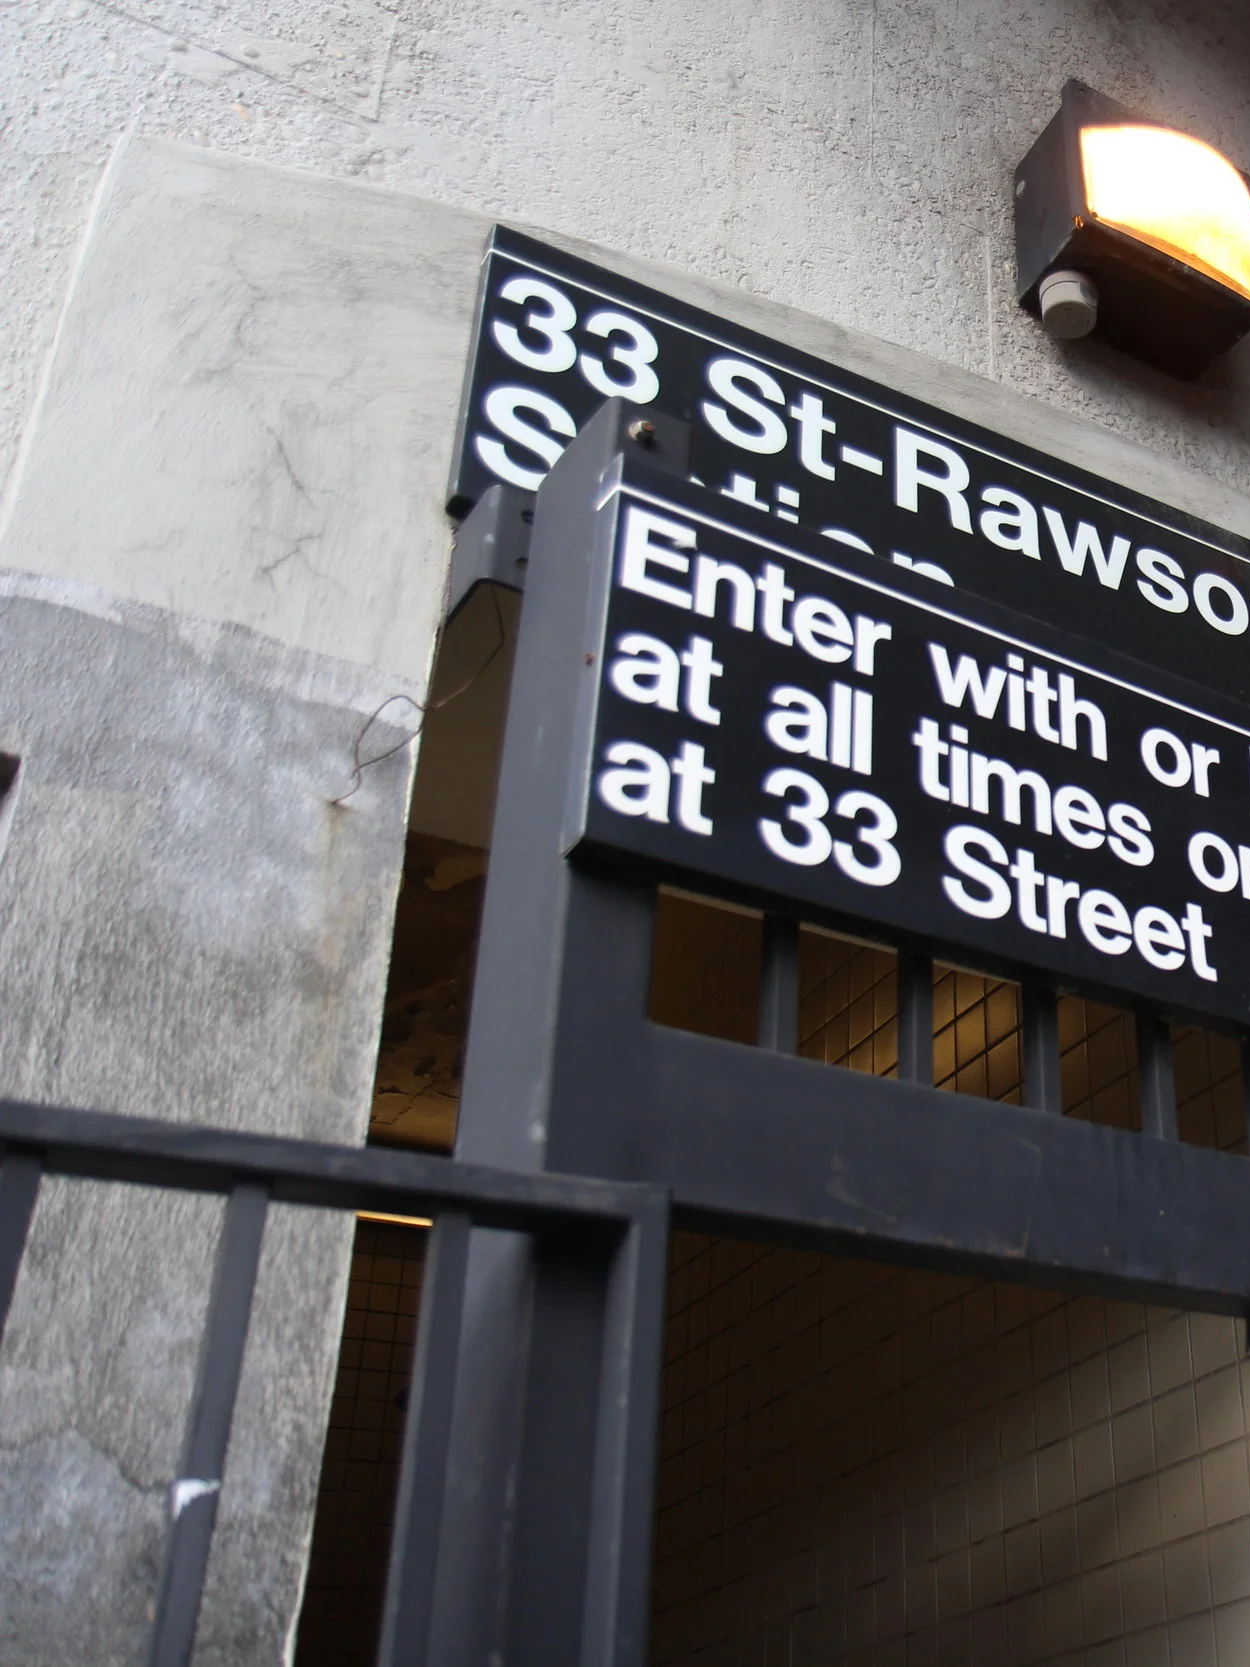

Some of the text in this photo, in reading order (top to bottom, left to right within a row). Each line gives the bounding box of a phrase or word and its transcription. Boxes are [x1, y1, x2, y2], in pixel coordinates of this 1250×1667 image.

[491, 277, 660, 405] 33
[609, 631, 725, 727] at
[764, 680, 874, 777] all
[912, 716, 1156, 868] times
[618, 504, 893, 677] Enter
[928, 641, 1109, 763] with
[1140, 726, 1221, 799] or
[597, 740, 1219, 983] at 33 Street
